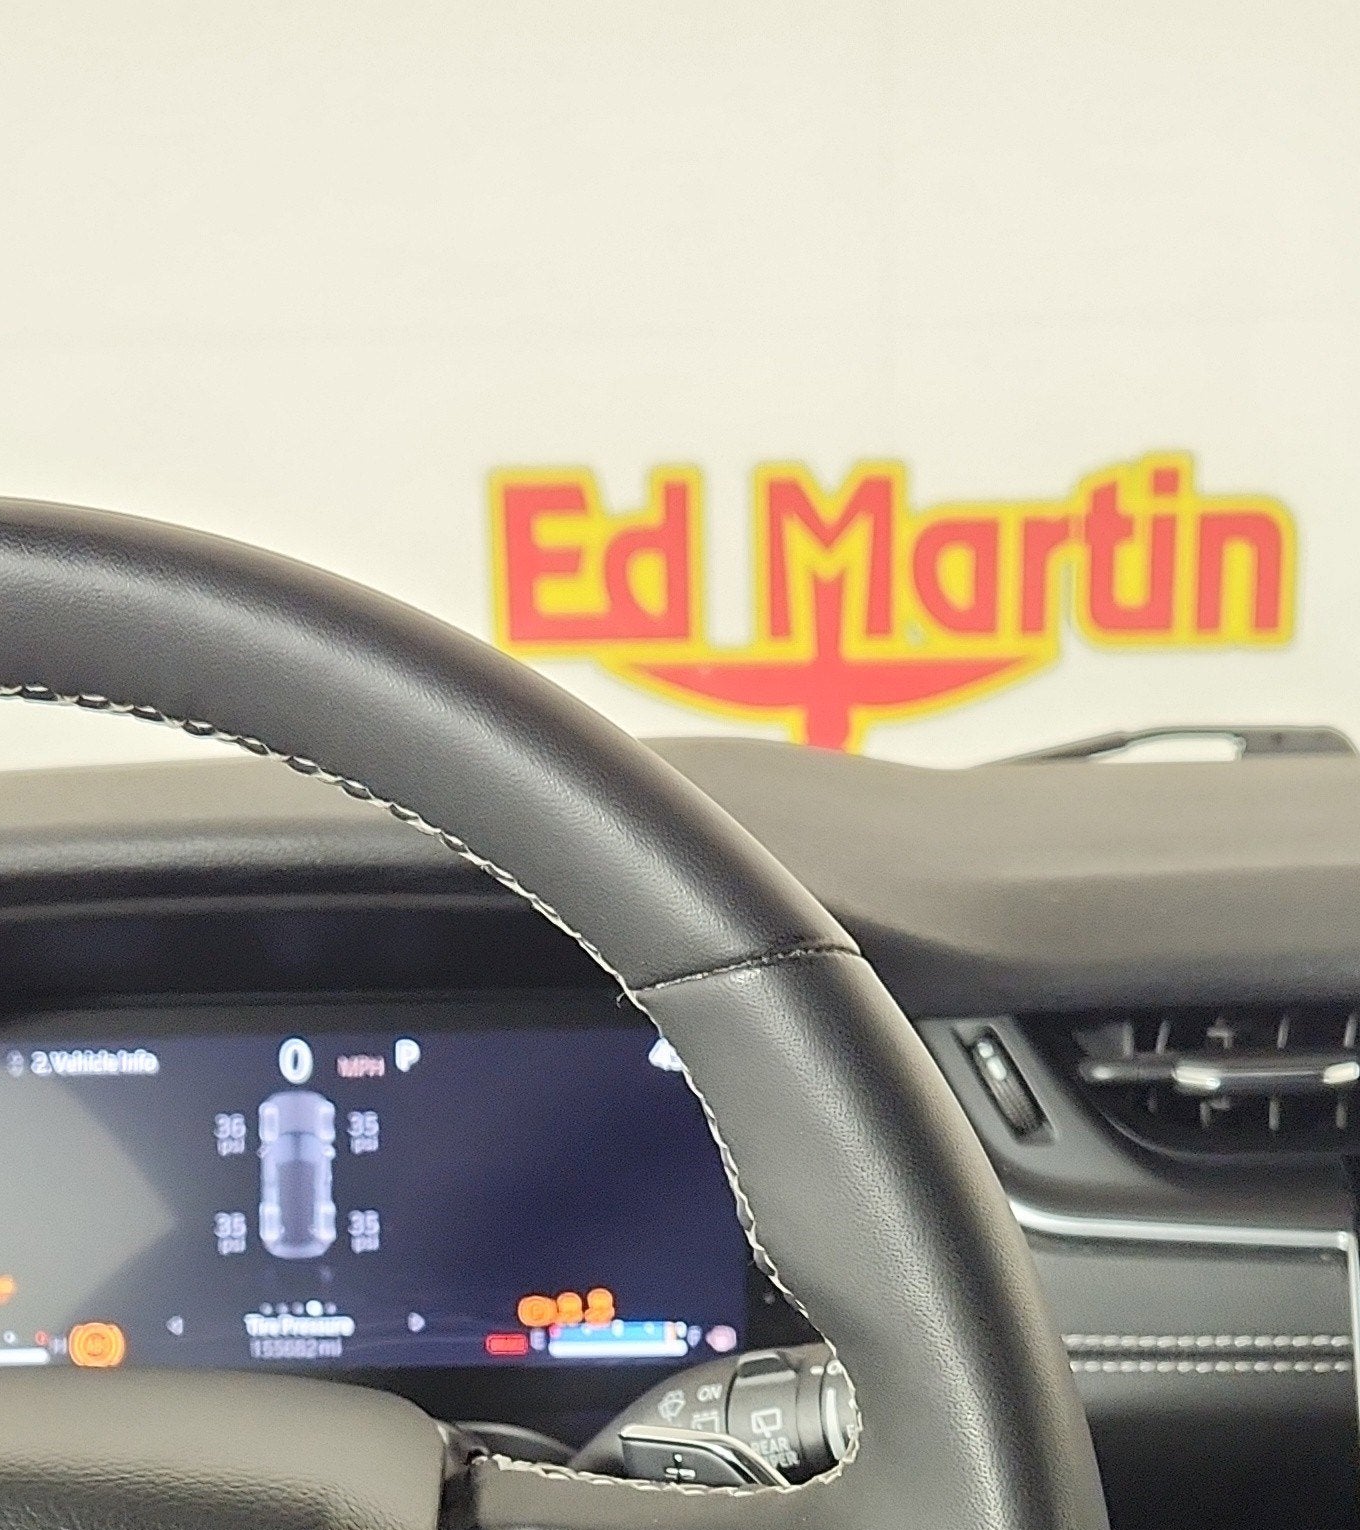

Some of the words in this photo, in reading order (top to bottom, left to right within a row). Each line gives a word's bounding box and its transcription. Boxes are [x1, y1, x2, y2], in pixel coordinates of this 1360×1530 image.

[495, 472, 695, 648] Ed
[760, 458, 1288, 645] Martin
[49, 1049, 120, 1075] Vehicle
[120, 1048, 159, 1075] Info
[278, 1037, 313, 1085] 0
[337, 1055, 385, 1078] MPH
[394, 1038, 421, 1073] P
[347, 1111, 380, 1137] 35
[214, 1211, 247, 1238] 35
[348, 1210, 380, 1236] 35
[243, 1313, 281, 1338] Tire
[280, 1314, 355, 1338] Pressure
[696, 1384, 724, 1402] ON
